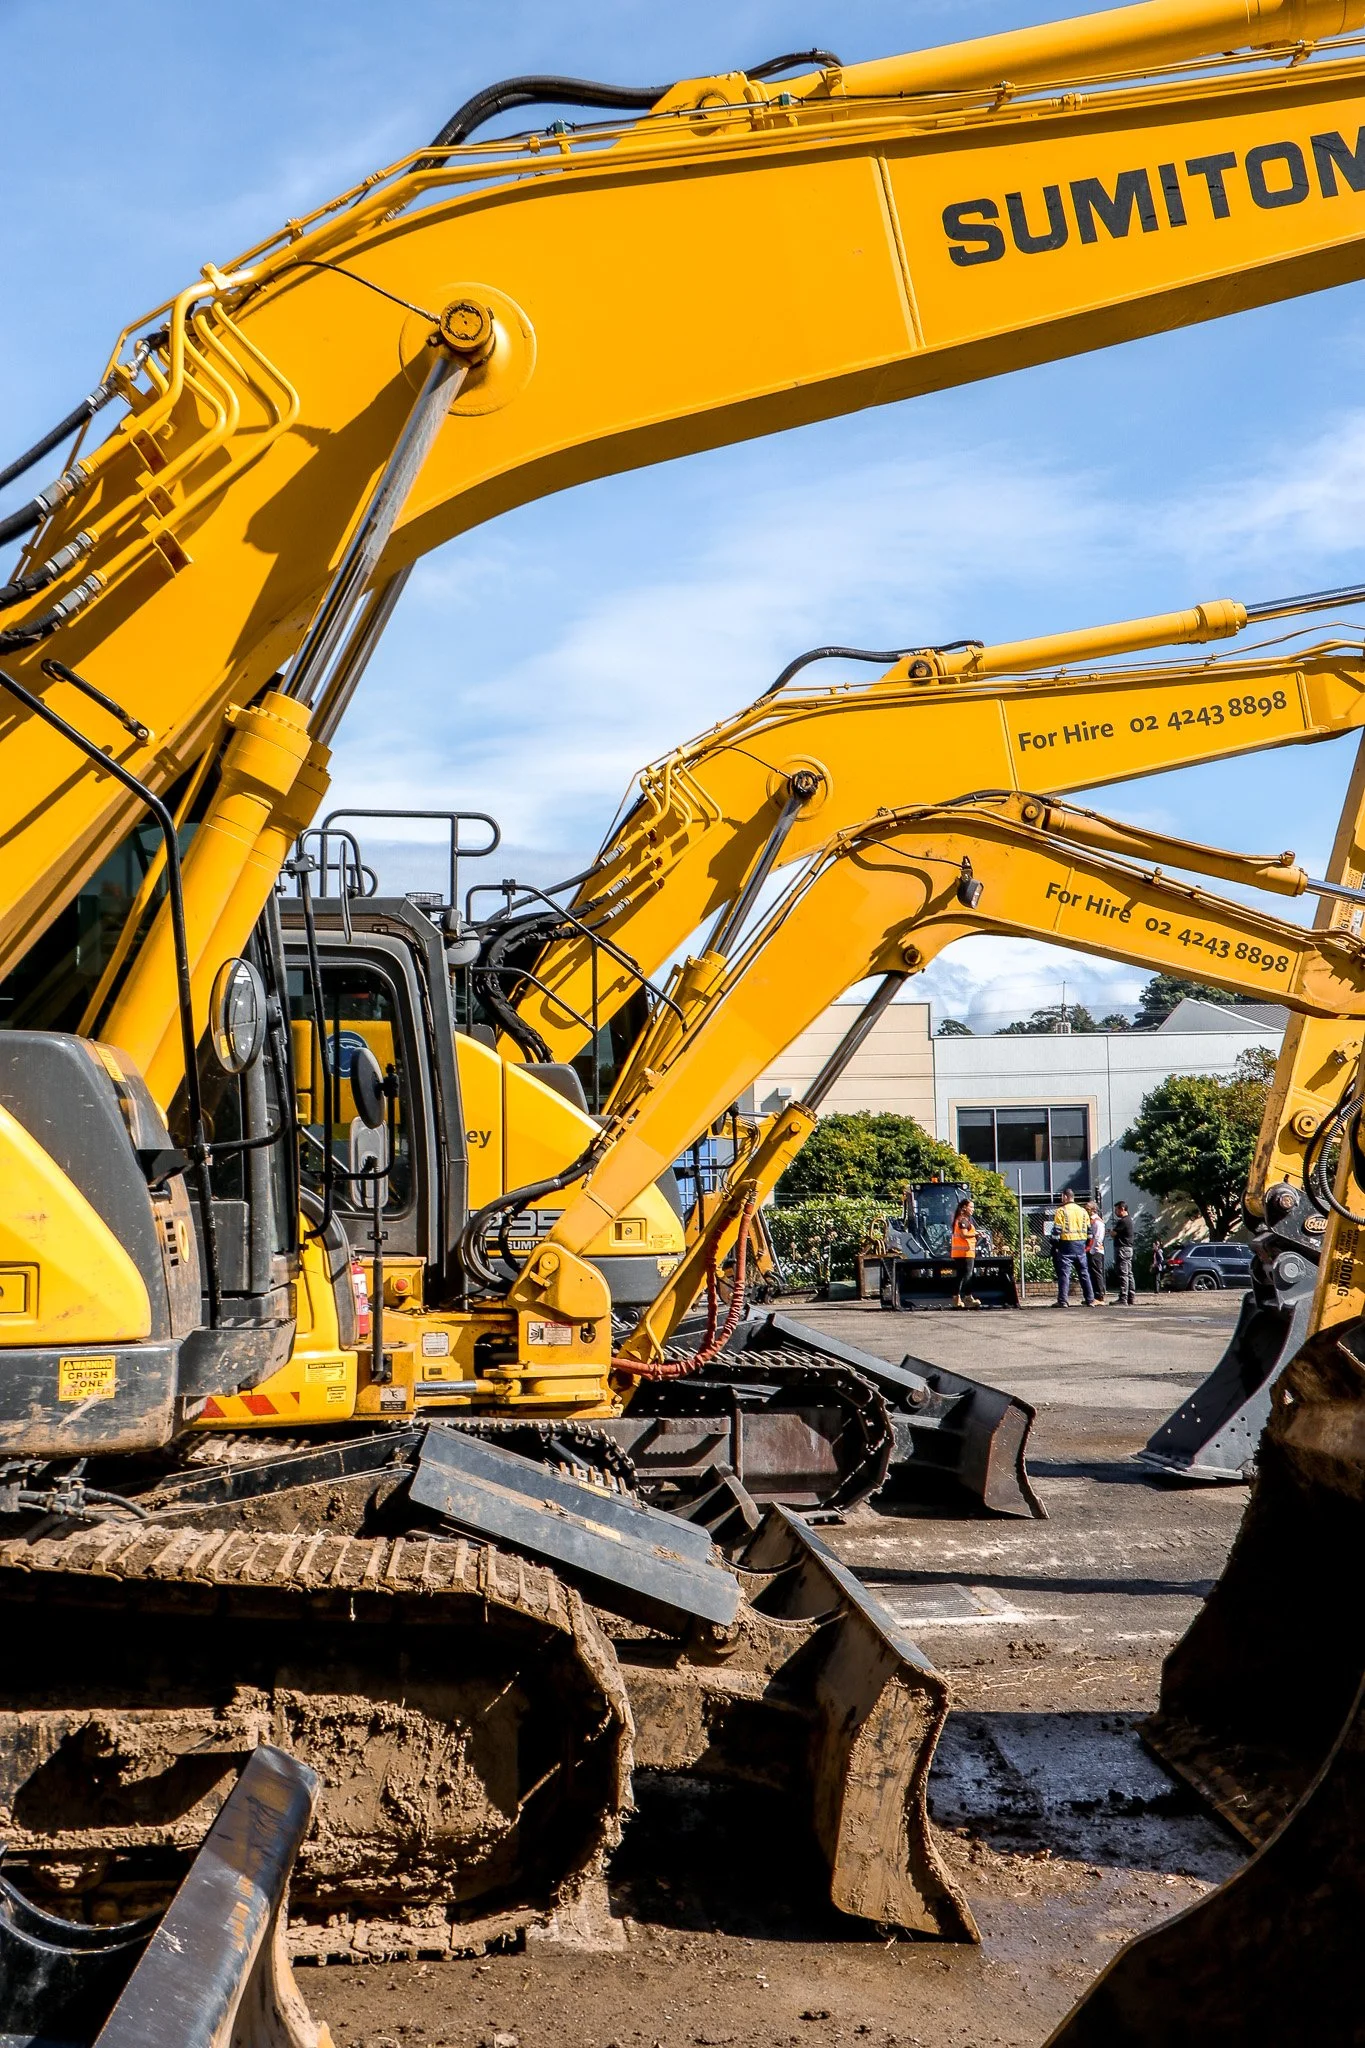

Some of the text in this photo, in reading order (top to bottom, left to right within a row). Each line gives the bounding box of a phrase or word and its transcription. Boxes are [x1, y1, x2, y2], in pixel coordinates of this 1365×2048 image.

[1018, 690, 1287, 752] For Hire 02 4243 8898
[1045, 882, 1289, 973] For Hire 02 4243 8898
[1337, 1257, 1354, 1297] 800KG
[68, 1371, 108, 1380] CRUSH
[73, 1360, 112, 1370] WARNING
